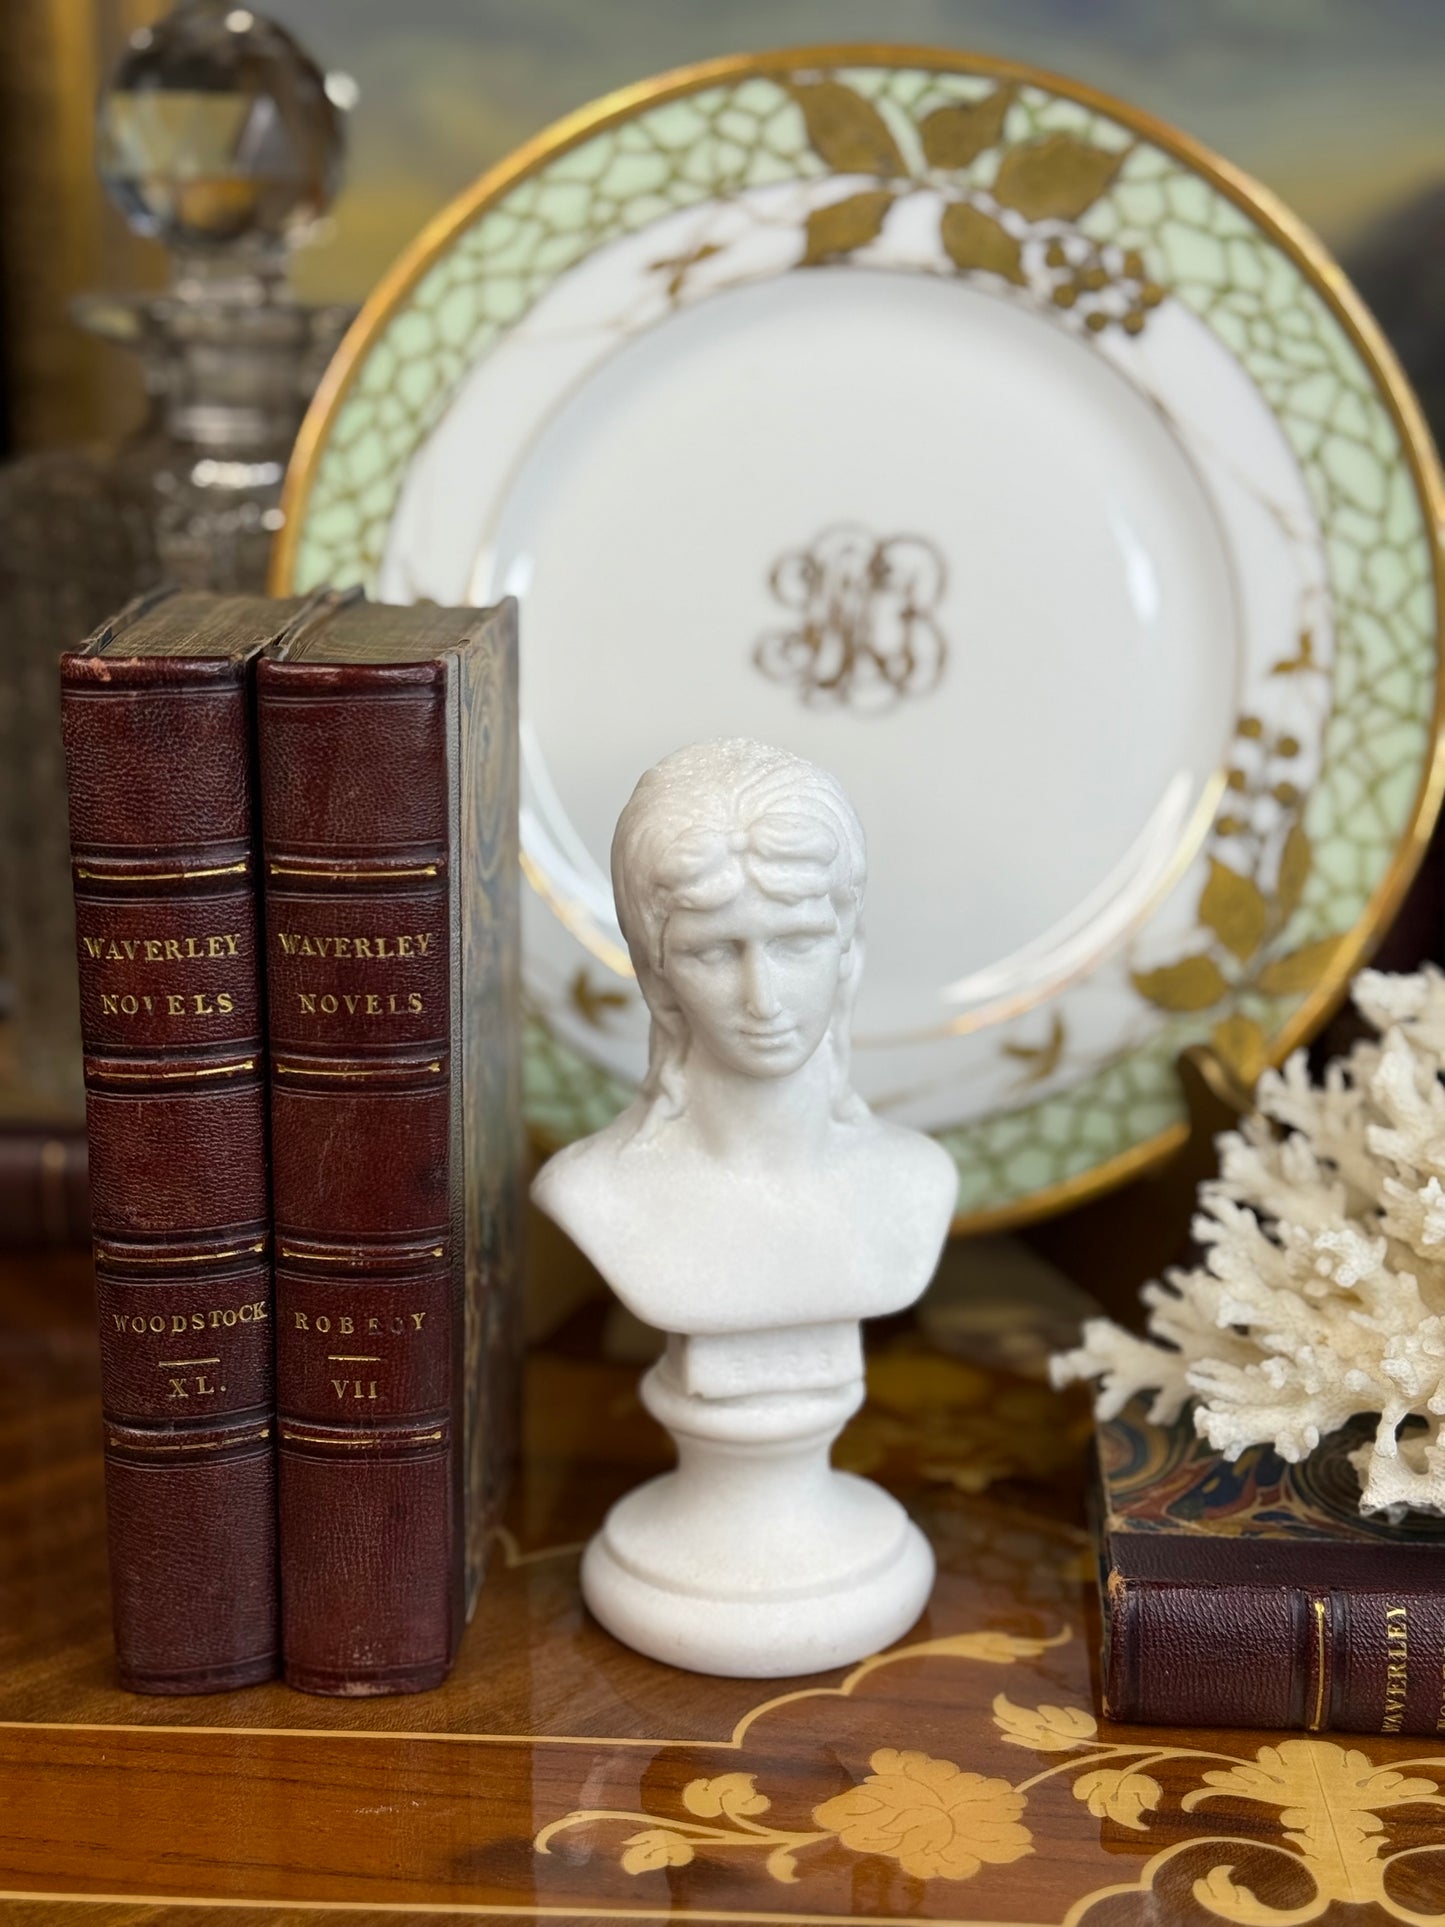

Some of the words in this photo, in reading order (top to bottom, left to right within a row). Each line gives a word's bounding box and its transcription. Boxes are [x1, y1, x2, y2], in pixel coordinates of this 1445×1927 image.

[84, 933, 241, 961] WAVERLEY
[279, 933, 433, 959] WAVERLEY
[101, 992, 235, 1016] NOVELS
[299, 993, 423, 1014] NOVELS
[112, 1301, 267, 1333] WOODSTOCK
[331, 1380, 379, 1399] VII
[1381, 1603, 1408, 1733] WAVERLEY
